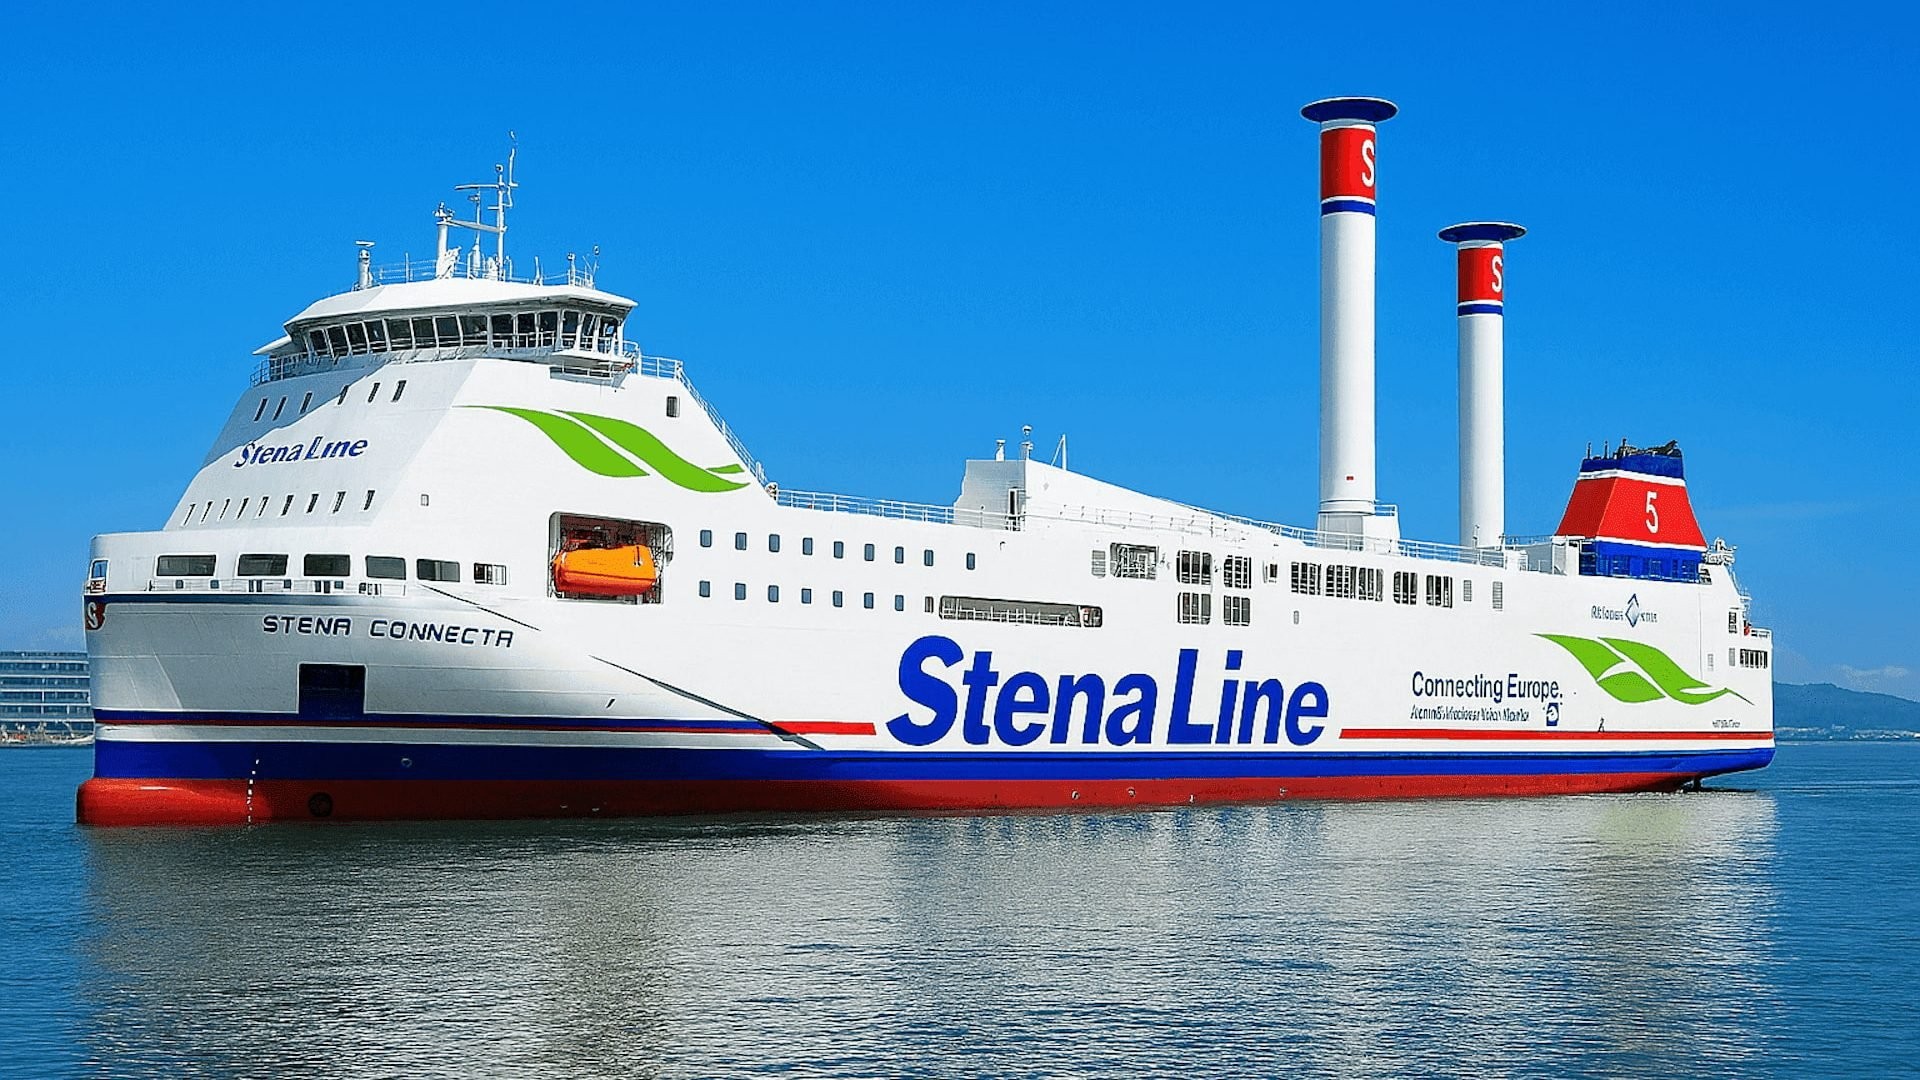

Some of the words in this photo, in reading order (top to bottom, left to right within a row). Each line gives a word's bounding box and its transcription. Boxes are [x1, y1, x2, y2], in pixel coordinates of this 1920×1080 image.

[1361, 139, 1376, 187] S
[233, 440, 303, 468] Stena
[303, 436, 368, 461] Line
[263, 615, 352, 636] STENA
[369, 619, 514, 648] CONNECTA
[885, 635, 1158, 747] Stena
[1166, 648, 1329, 746] Line
[1412, 671, 1503, 703] Connecting
[1507, 673, 1563, 703] Europe.
